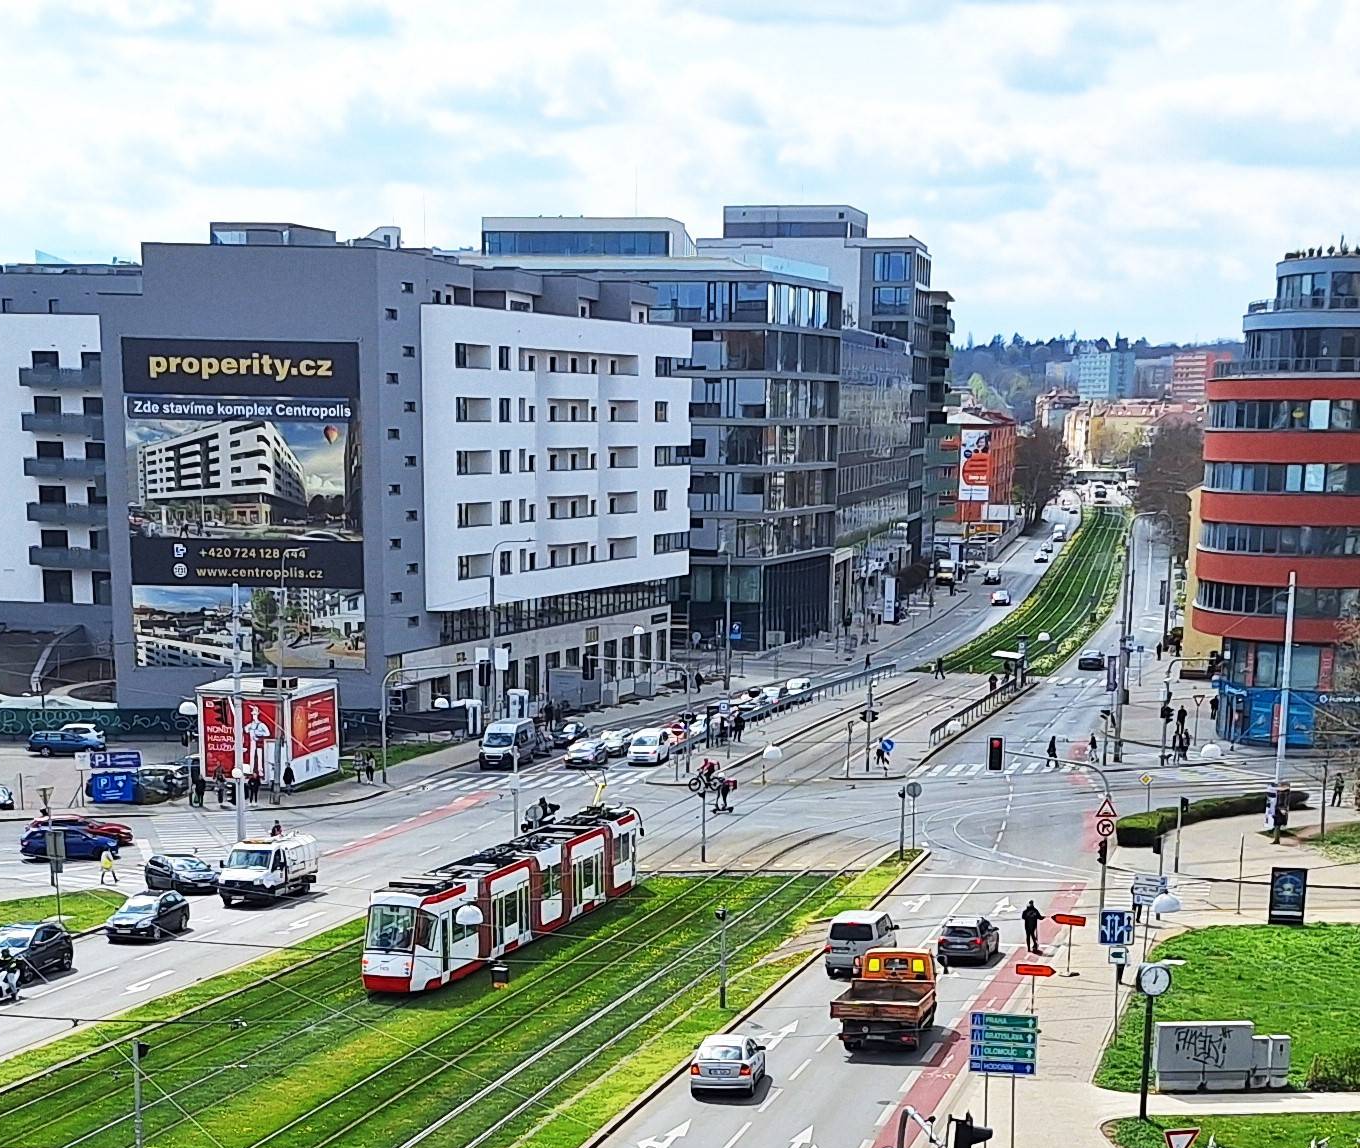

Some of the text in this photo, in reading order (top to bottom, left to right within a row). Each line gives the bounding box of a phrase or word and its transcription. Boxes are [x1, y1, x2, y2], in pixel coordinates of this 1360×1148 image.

[149, 353, 333, 381] properity.cz
[133, 401, 352, 419] Zde stavíme komplex Centropolis
[199, 547, 232, 559] +420
[233, 547, 256, 559] 724
[259, 548, 280, 559] 128
[196, 567, 324, 579] www.centropolis.cz
[985, 1016, 1007, 1025] PRAHA
[985, 1032, 1023, 1041] BRATISLAVA
[984, 1047, 1017, 1056] OLOMOUC
